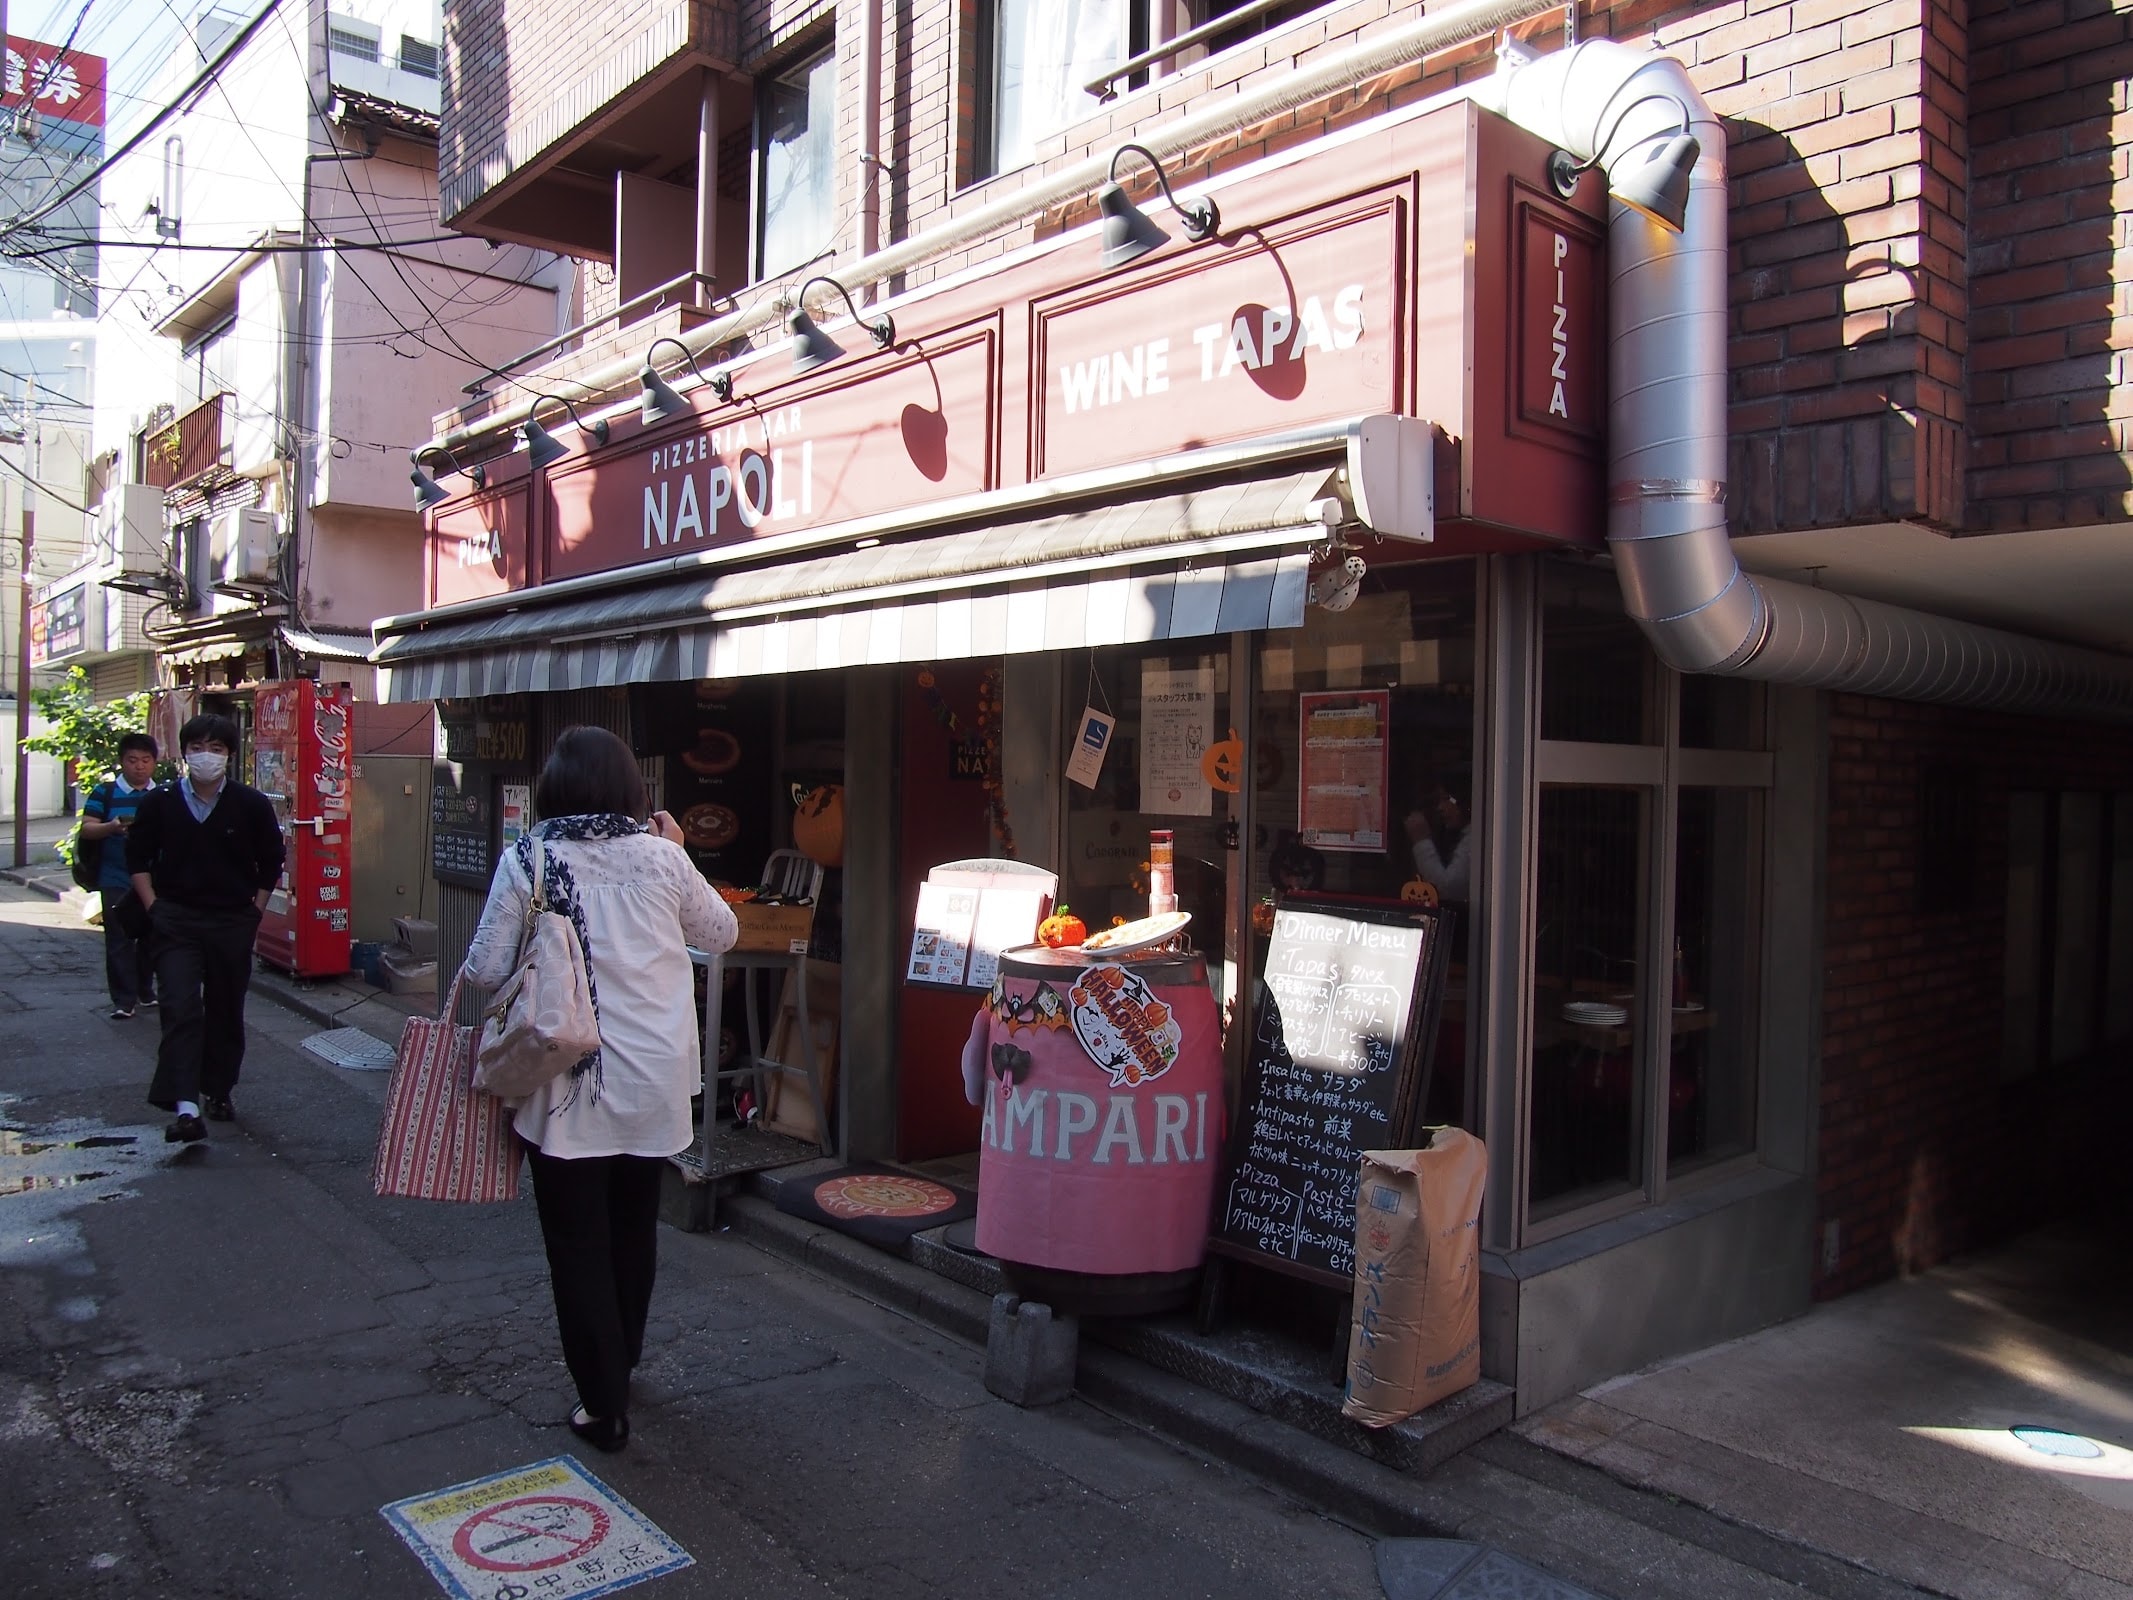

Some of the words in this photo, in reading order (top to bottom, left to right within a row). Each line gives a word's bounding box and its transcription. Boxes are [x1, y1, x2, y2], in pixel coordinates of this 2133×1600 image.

[1549, 233, 1568, 419] PIZZA
[1061, 338, 1170, 414] WINE
[1193, 284, 1365, 383] TAPAS
[652, 429, 748, 474] PIZZERIA
[758, 406, 803, 440] BAR
[643, 440, 813, 550] NAPOLI
[458, 528, 502, 568] PIZZA
[957, 745, 986, 755] PIZZE
[1283, 916, 1344, 942] Dinner
[1346, 921, 1406, 949] Menu
[1287, 948, 1338, 980] Tapas
[1351, 965, 1385, 984] タパス
[1081, 966, 1168, 1075] HALLOWEEN
[1121, 997, 1155, 1031] HAPPY
[1338, 1050, 1378, 1072] ¥500
[1375, 1048, 1389, 1059] etc
[1262, 1059, 1313, 1083] Insalata
[1322, 1072, 1367, 1093] サラダ
[1256, 1099, 1315, 1129] Antipasto
[1323, 1114, 1353, 1142] 前菜
[1242, 1162, 1280, 1188] Pizza
[1238, 1188, 1291, 1215] マルゲリータ
[1302, 1181, 1344, 1209] Pasta
[1340, 1184, 1358, 1200] et
[1259, 1237, 1285, 1255] etc
[1330, 1254, 1354, 1273] etc
[534, 1543, 650, 1587] 中野区
[613, 1555, 665, 1576] Office
